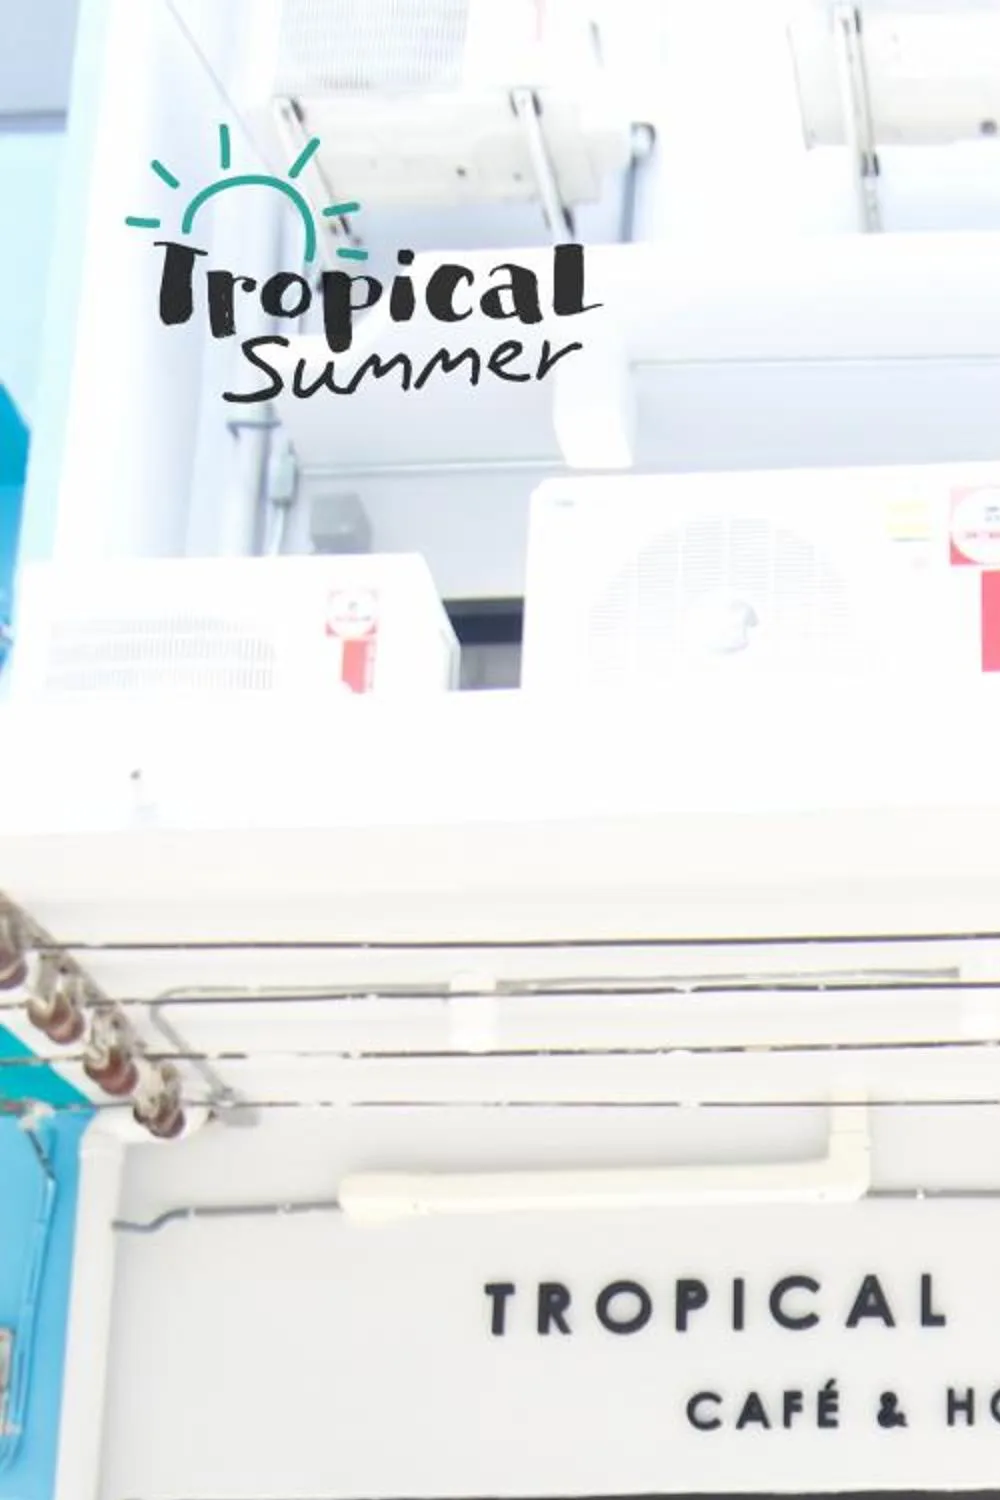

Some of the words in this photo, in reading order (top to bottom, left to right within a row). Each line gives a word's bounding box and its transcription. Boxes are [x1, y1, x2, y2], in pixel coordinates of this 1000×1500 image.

[485, 1274, 945, 1335] TROPICAL
[687, 1379, 838, 1430] CAFÉ
[877, 1392, 907, 1428] &
